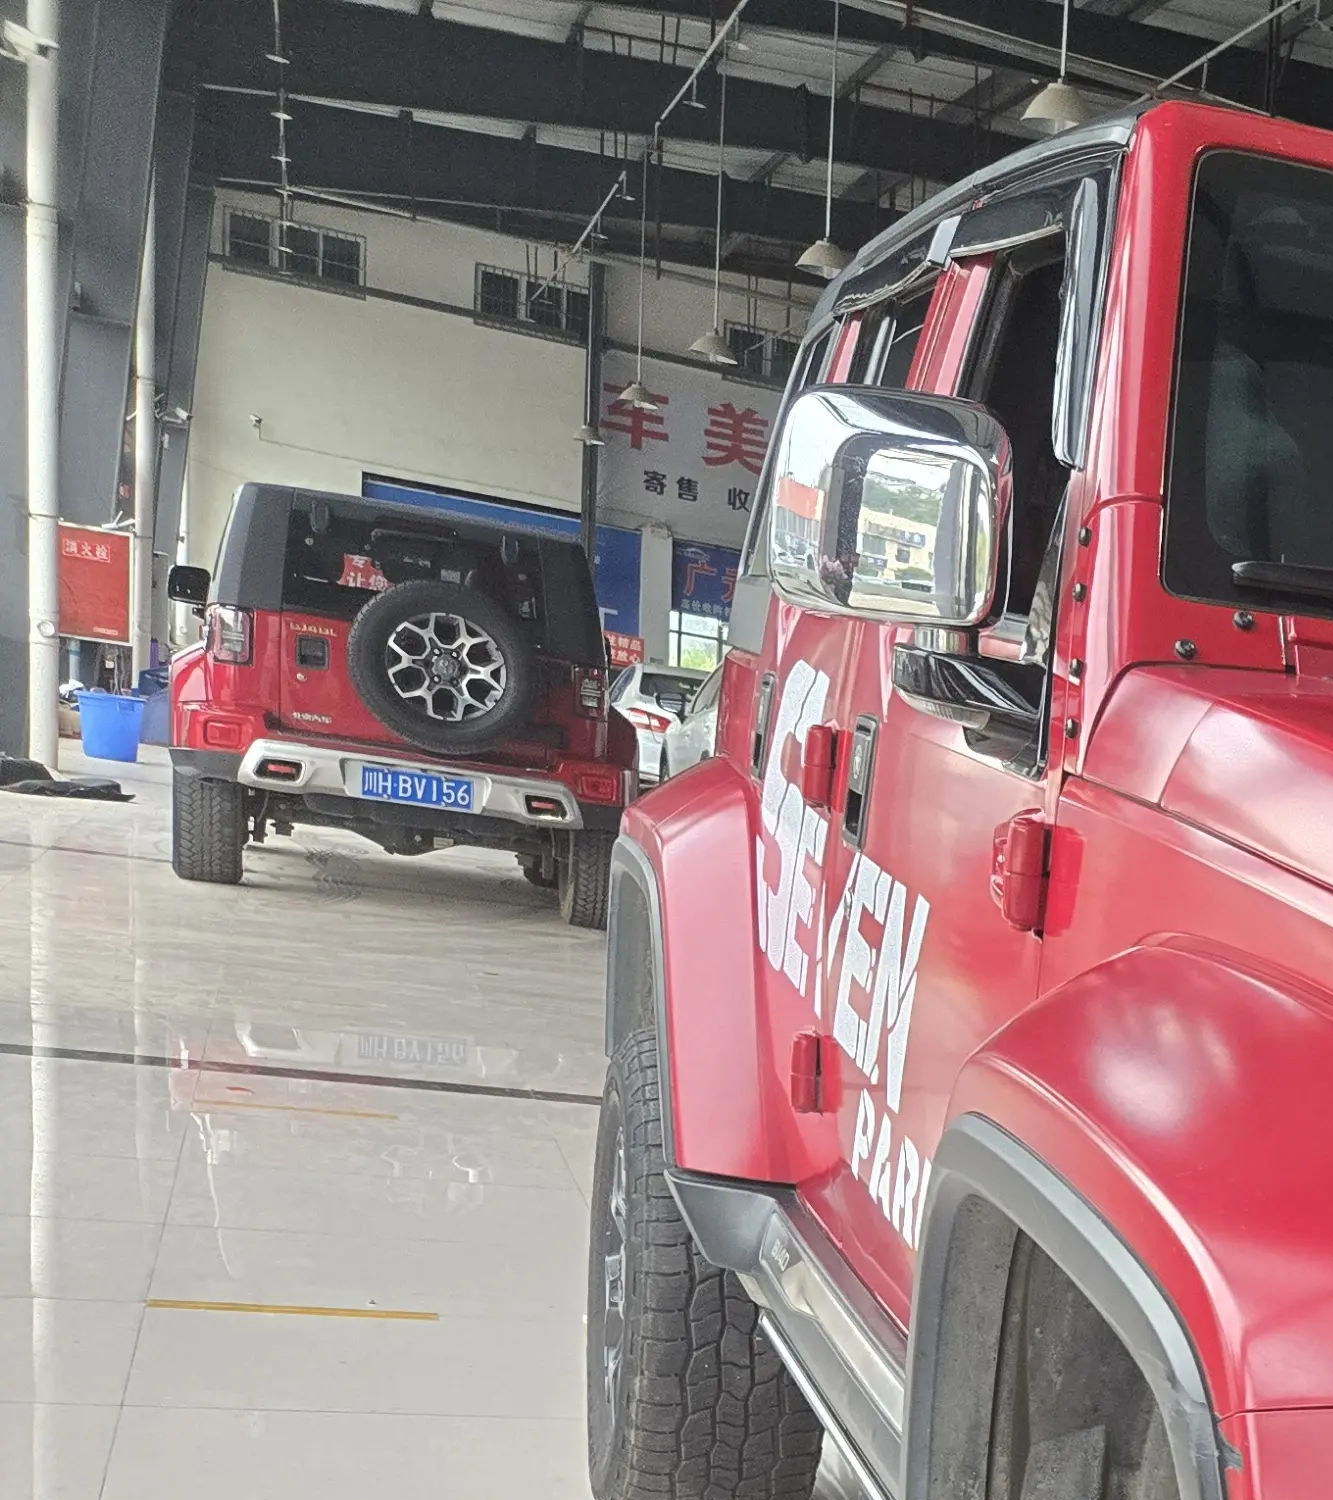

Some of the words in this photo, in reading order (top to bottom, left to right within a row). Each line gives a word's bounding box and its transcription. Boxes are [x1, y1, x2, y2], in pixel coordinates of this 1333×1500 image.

[643, 470, 699, 502] 寄售
[65, 539, 108, 559] 消火栓
